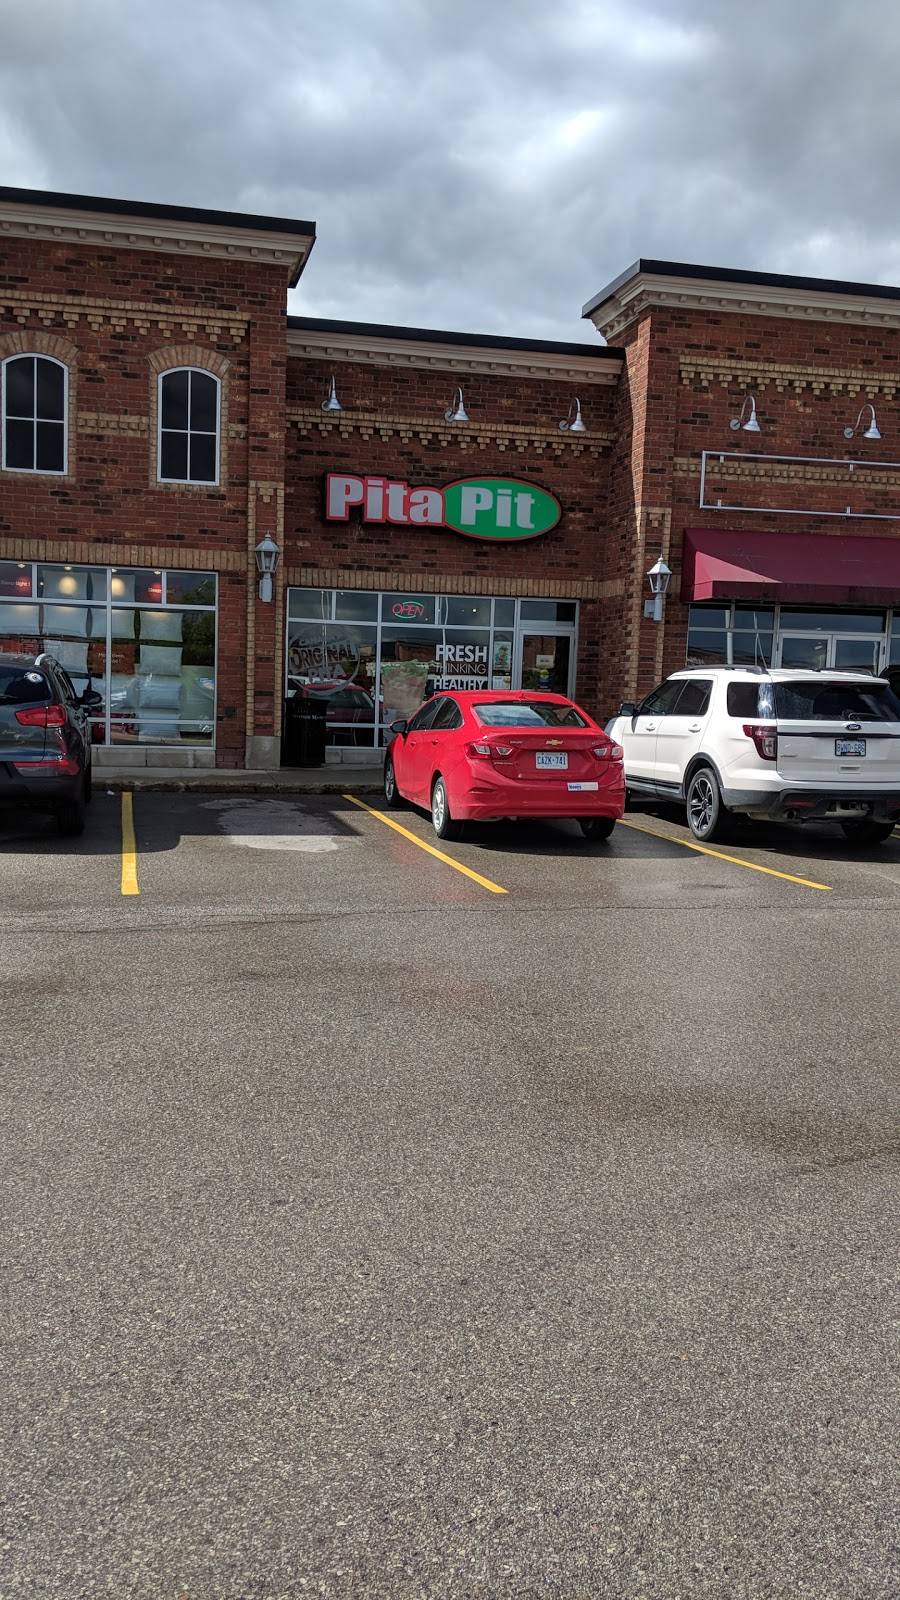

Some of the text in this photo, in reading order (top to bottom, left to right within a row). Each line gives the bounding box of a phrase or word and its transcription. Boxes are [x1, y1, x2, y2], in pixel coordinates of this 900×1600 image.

[328, 475, 536, 530] Pita Pit
[392, 603, 424, 616] OPEN
[435, 644, 488, 663] FRESH
[433, 678, 485, 691] HEALTHY
